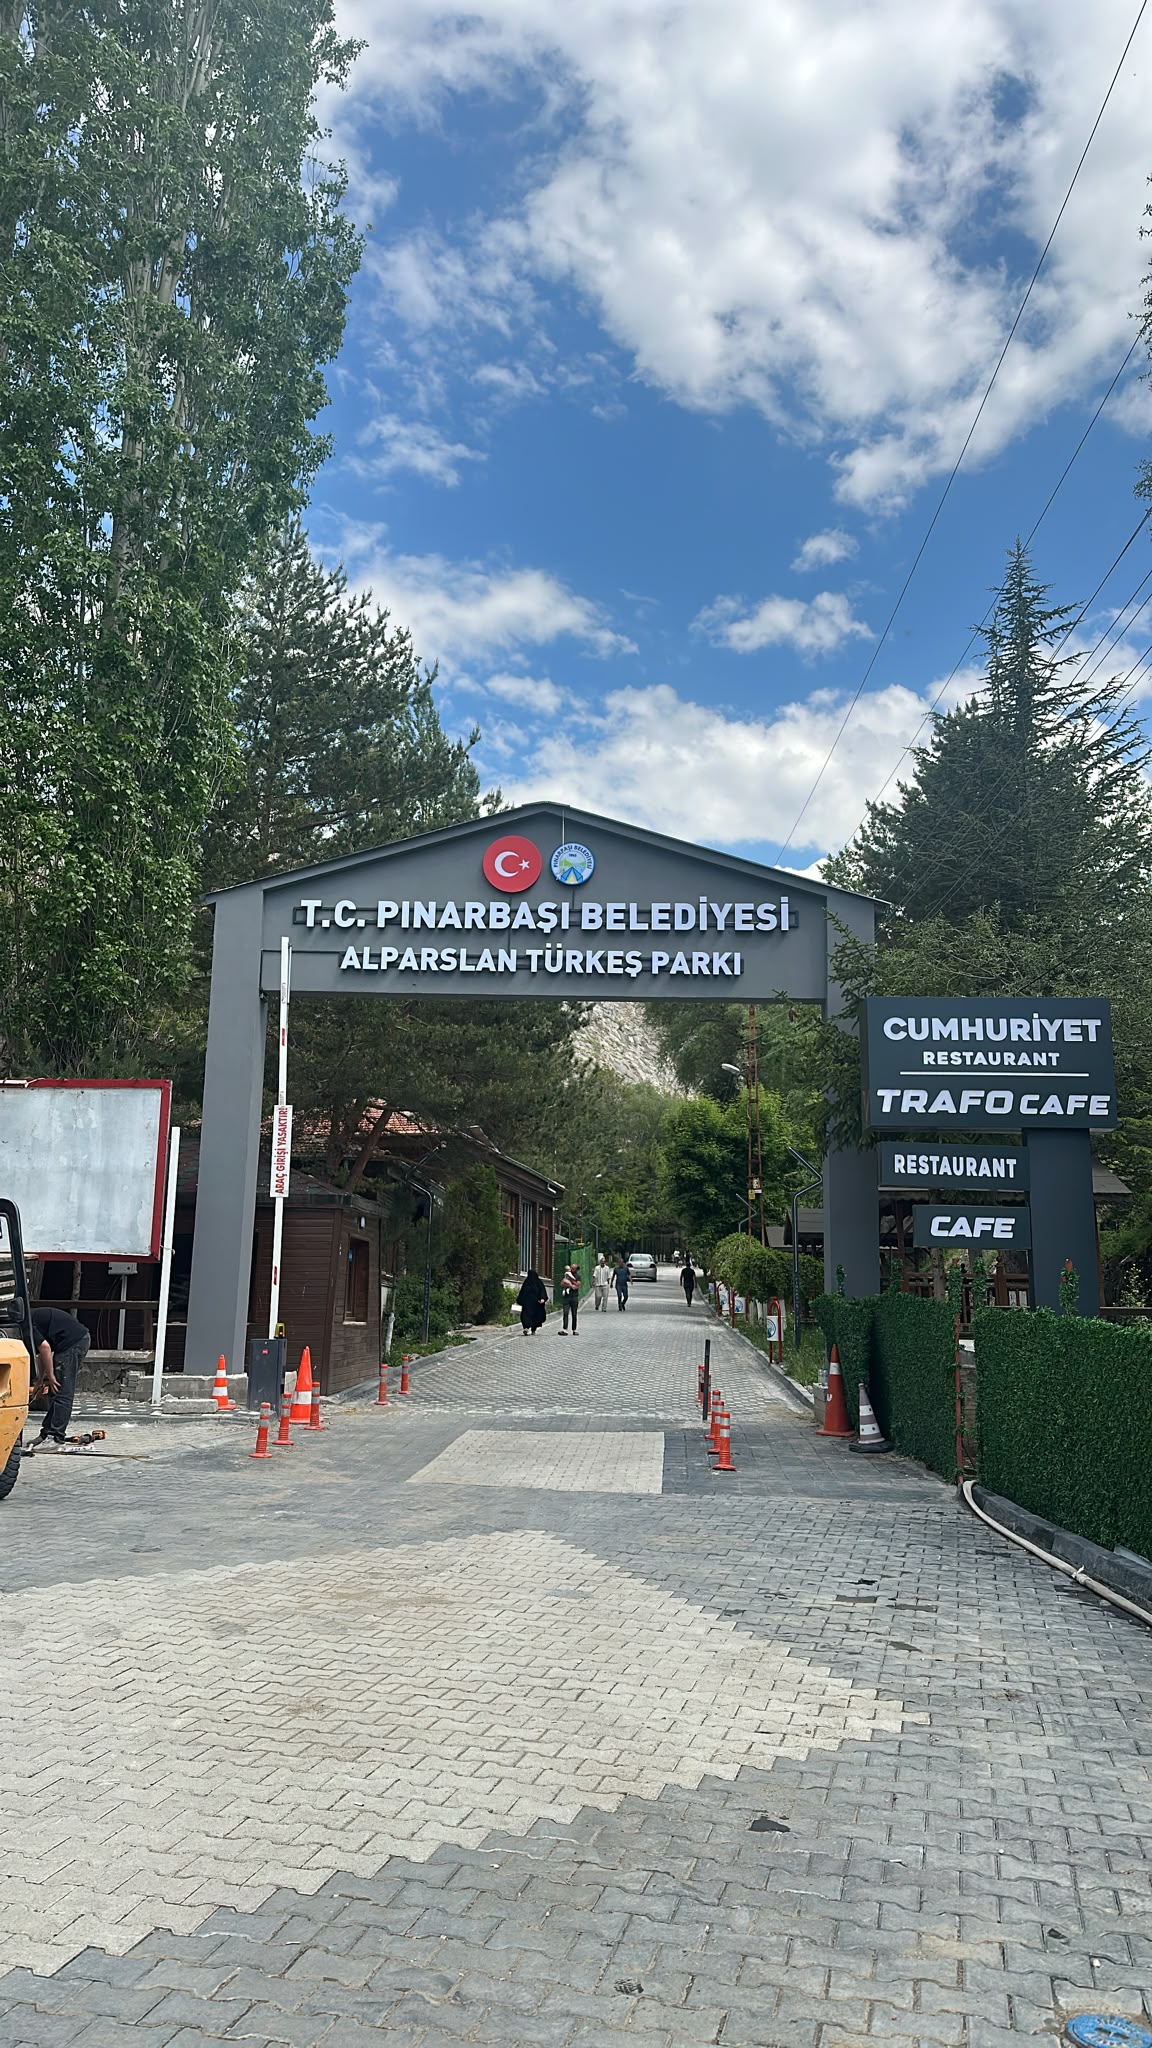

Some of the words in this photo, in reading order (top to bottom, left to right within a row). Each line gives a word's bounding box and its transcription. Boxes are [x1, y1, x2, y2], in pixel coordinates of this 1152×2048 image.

[300, 899, 366, 928] T.C.
[377, 900, 571, 934] PINARBAŞI
[581, 895, 789, 931] BELEDİYESİ
[340, 945, 517, 972] ALPARSLAN
[525, 942, 643, 978] TÜRKEŞ
[651, 951, 741, 975] PARKI
[883, 1012, 1102, 1042] CUMHURİYET
[922, 1051, 1060, 1066] RESTAURANT
[876, 1089, 1014, 1114] TRAFO
[1019, 1094, 1111, 1116] CAFE
[273, 1148, 289, 1172] GİRİŞİ
[894, 1154, 1017, 1179] RESTAURANT
[274, 1173, 288, 1195] ARAÇ
[930, 1216, 1016, 1239] CAFE
